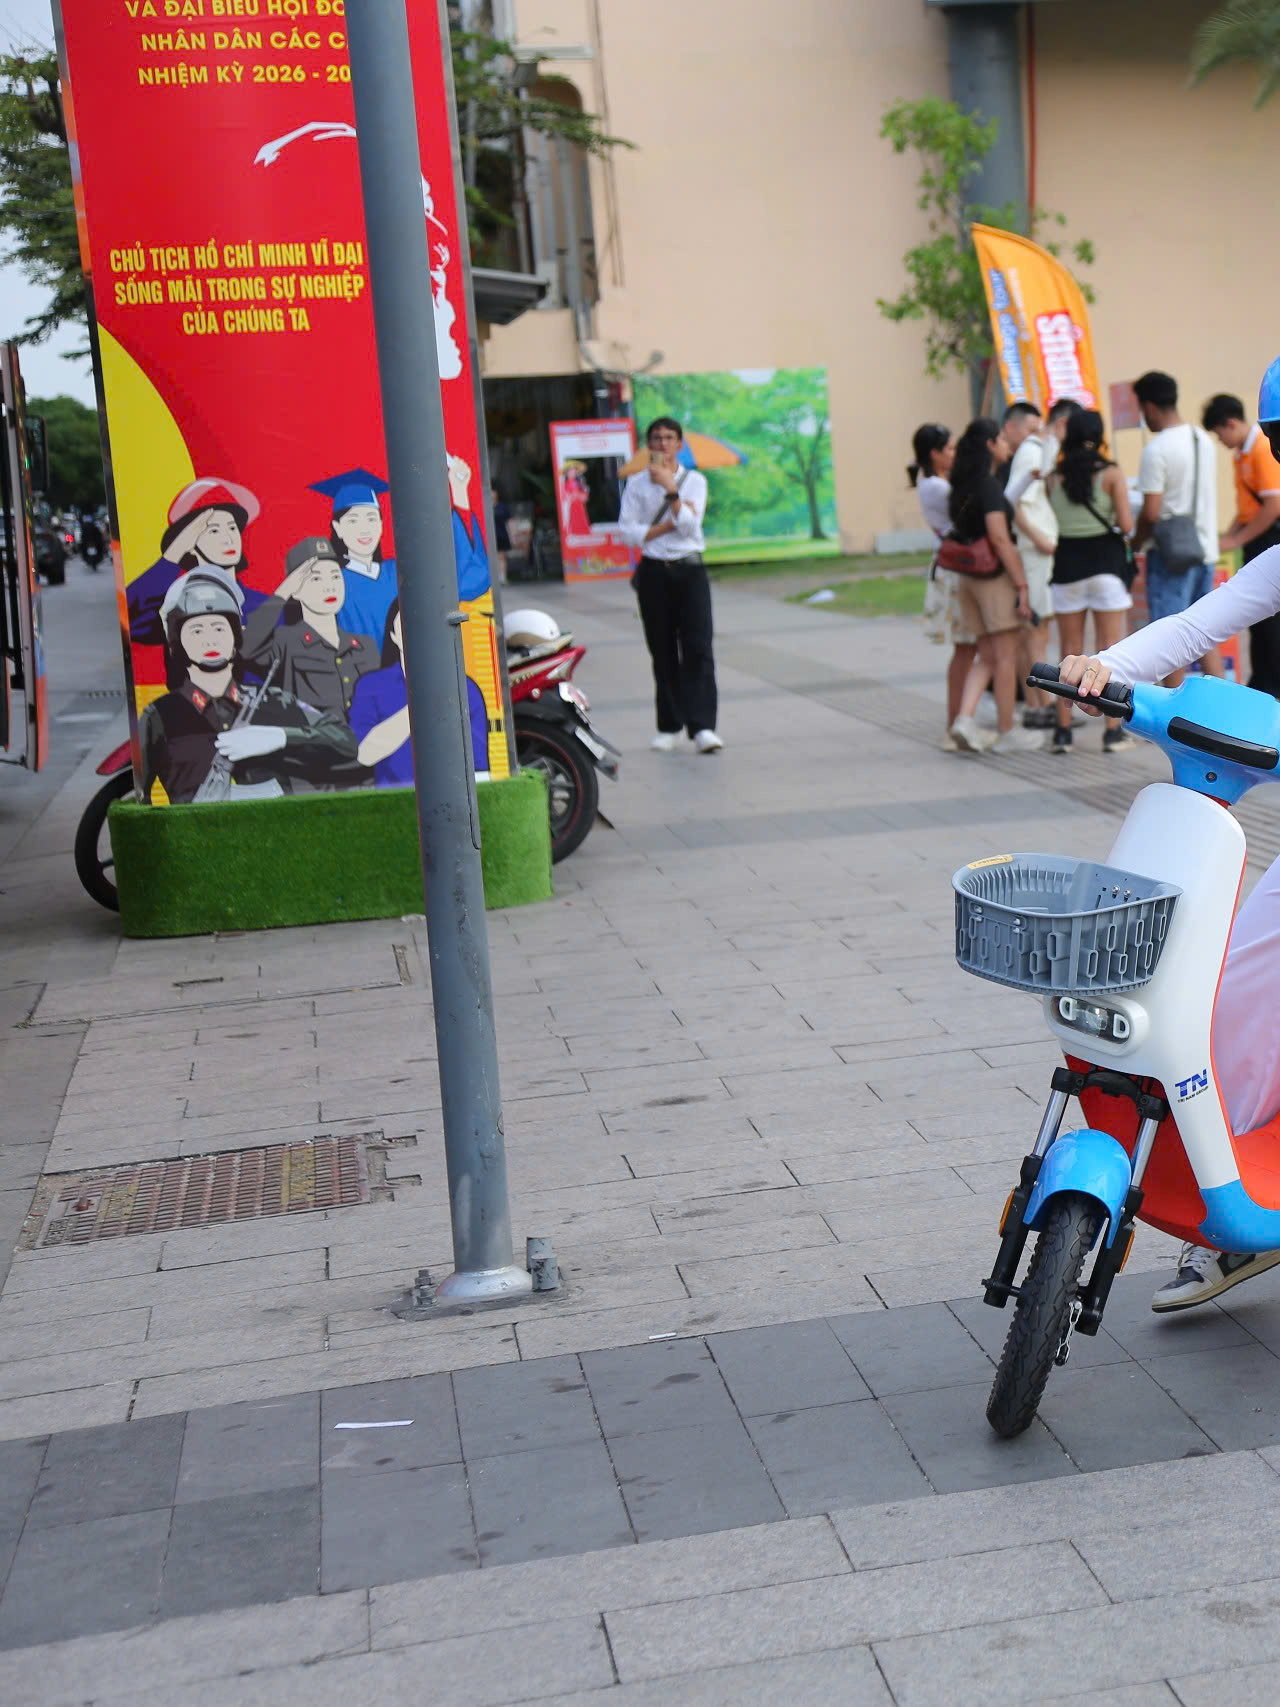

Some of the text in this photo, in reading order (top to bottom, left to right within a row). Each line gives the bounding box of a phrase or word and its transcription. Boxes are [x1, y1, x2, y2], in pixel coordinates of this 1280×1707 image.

[164, 0, 204, 20] ĐẠI
[142, 29, 206, 51] NHÂN
[214, 27, 262, 49] DÂN
[270, 27, 320, 49] CÁC
[139, 62, 208, 88] NHIỆM
[217, 61, 244, 83] KỲ
[253, 65, 306, 82] 2026
[110, 238, 363, 275] CHỦ TỊCH HỒ CHÍ MINH VĨ ĐẠI
[115, 270, 364, 304] SỐNG MÃI TRONG SỰ NGHIỆP
[183, 304, 310, 334] CỦA CHÚNG TA
[1175, 1068, 1207, 1097] TN
